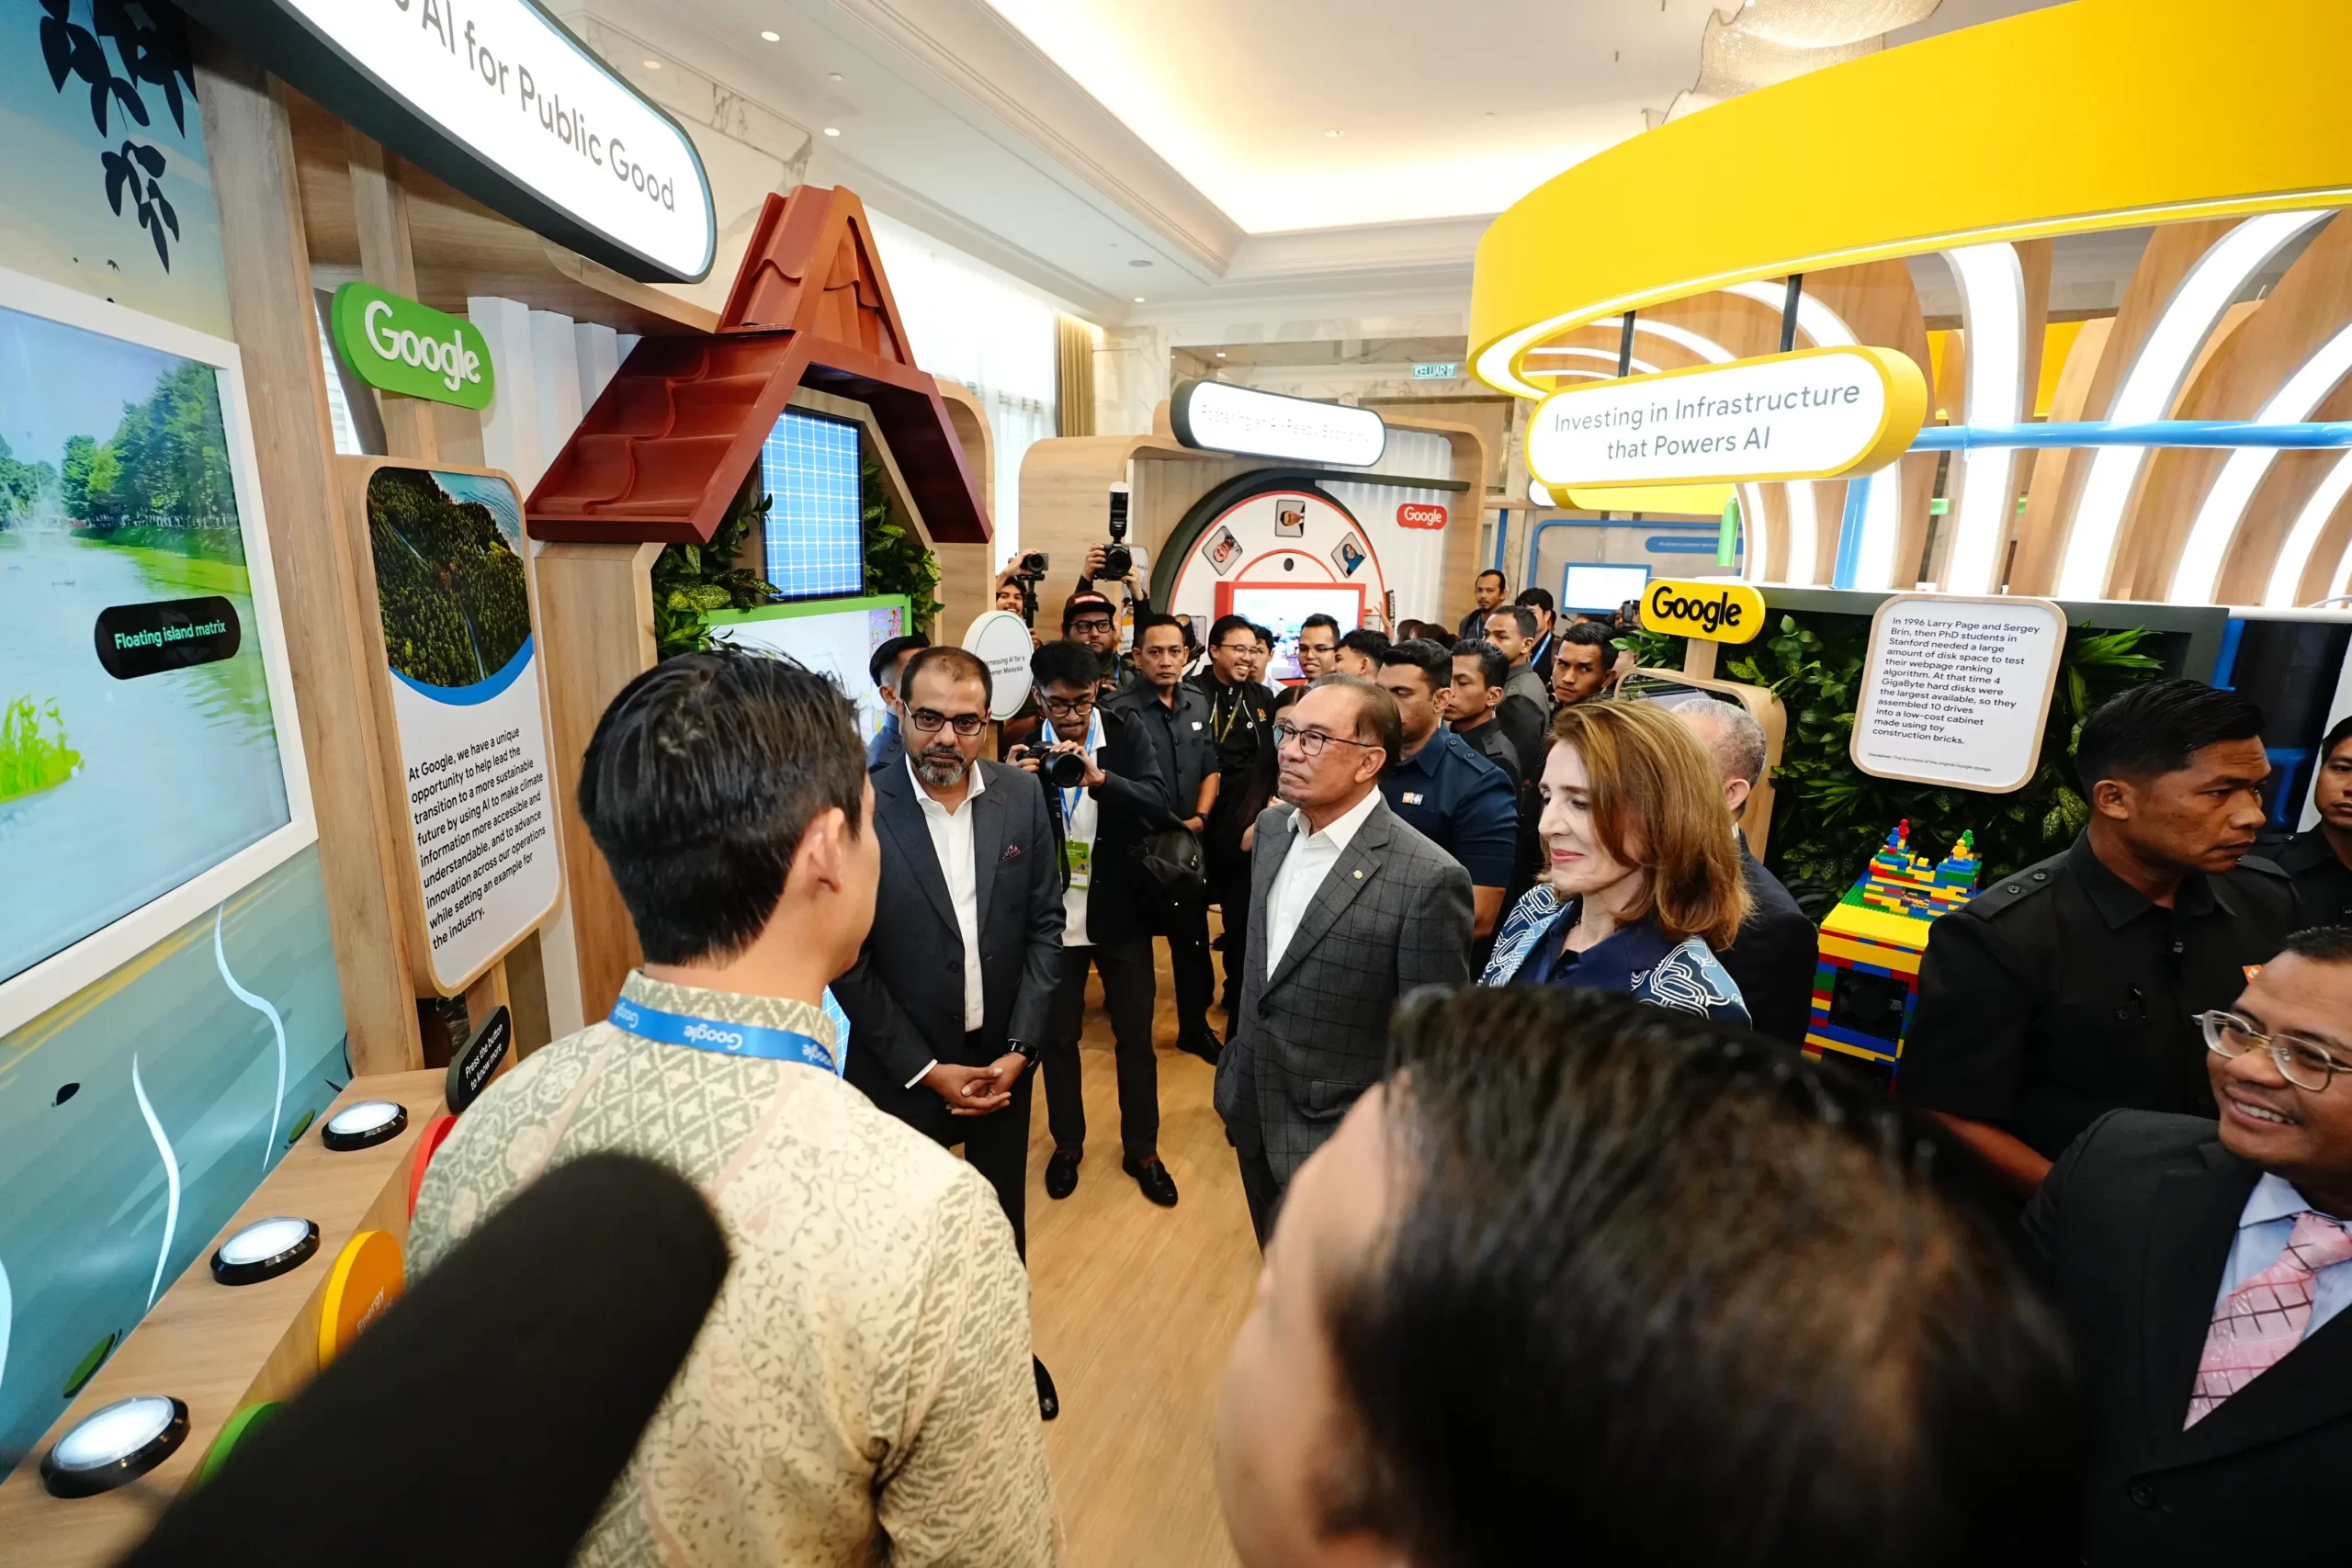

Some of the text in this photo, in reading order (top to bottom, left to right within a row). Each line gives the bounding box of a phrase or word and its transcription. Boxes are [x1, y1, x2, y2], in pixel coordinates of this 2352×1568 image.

[422, 0, 675, 213] AI for Public Good
[364, 300, 481, 392] Google
[1415, 366, 1447, 377] KELUAR
[1555, 385, 1860, 432] Investing in Infrastructure
[1607, 426, 1770, 459] that Powers AI
[1404, 506, 1442, 526] Google
[1652, 585, 1742, 632] Google
[114, 619, 227, 649] Floating island matrix
[1891, 627, 1911, 636] Brin,
[1915, 629, 1937, 637] then
[1939, 630, 1959, 638] PhD
[1961, 633, 2005, 641] students
[1904, 618, 1925, 626] 1996
[1928, 619, 1953, 629] Larry
[1955, 620, 1979, 630] Page
[2003, 623, 2040, 635] Sergey
[1887, 649, 1922, 658] amount
[2005, 657, 2025, 665] test
[1889, 637, 1929, 647] Stanford
[1931, 642, 1968, 650] needed
[1979, 644, 2005, 654] large
[984, 658, 1008, 666] arnessing
[1003, 666, 1023, 674] Malaysia
[1883, 669, 1930, 678] algorithm.
[1947, 673, 1966, 682] that
[1969, 675, 1992, 683] time
[1909, 661, 1953, 671] webpage
[1955, 665, 1993, 674] ranking
[1882, 678, 1925, 689] GigaByte
[1928, 682, 1949, 691] hard
[1951, 684, 1975, 693] disks
[1897, 690, 1929, 699] largest
[1931, 694, 1976, 705] available,
[1994, 699, 2017, 709] they
[1876, 708, 1894, 716] into
[1903, 710, 1945, 722] low-cost
[1947, 716, 1984, 726] cabinet
[1878, 699, 1928, 709] assembled
[1944, 705, 1973, 714] drives
[1872, 728, 1964, 744] construction bricks.
[1874, 718, 1945, 733] made using toy
[409, 728, 520, 782] At Google, we have a unique
[412, 746, 521, 805] opportunity to help lead the
[414, 758, 534, 825] transition to a more sustainable
[417, 773, 543, 846] future by using AI to make climate
[420, 790, 541, 868] information more accessible and
[424, 810, 541, 888] understandable, and to advance
[426, 827, 546, 909] innovation across our operations
[429, 852, 533, 930] while setting an example for
[433, 907, 485, 950] the industry.
[465, 1023, 503, 1079] Press the button
[684, 1023, 743, 1051] Google
[802, 1043, 833, 1066] oogle
[470, 1043, 503, 1091] to know more
